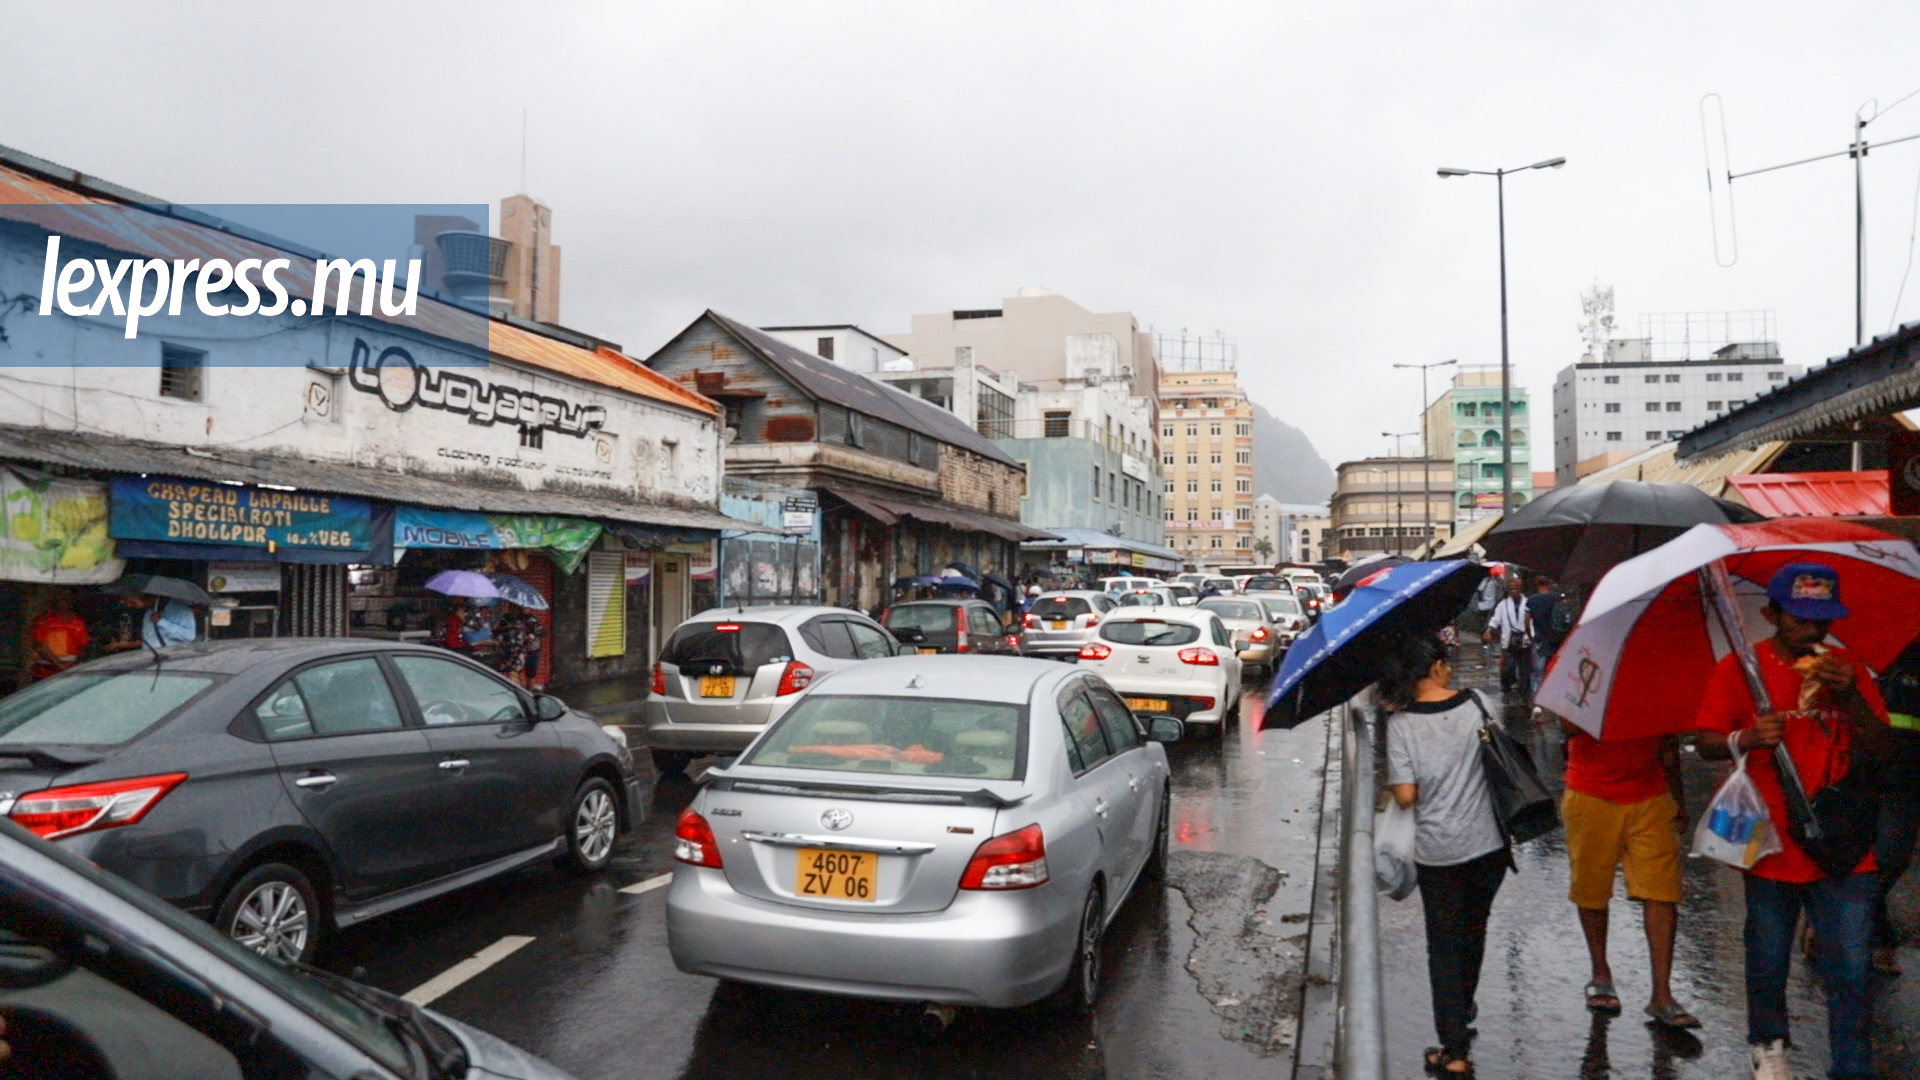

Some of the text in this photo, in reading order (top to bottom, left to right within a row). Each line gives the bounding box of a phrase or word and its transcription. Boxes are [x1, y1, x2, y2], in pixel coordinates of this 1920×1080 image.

[168, 501, 292, 527] SPECIAL ROTI
[249, 492, 330, 514] LAPAILLE
[402, 525, 492, 549] MOBILE
[813, 853, 862, 875] 4607
[803, 874, 869, 898] ZV 06
